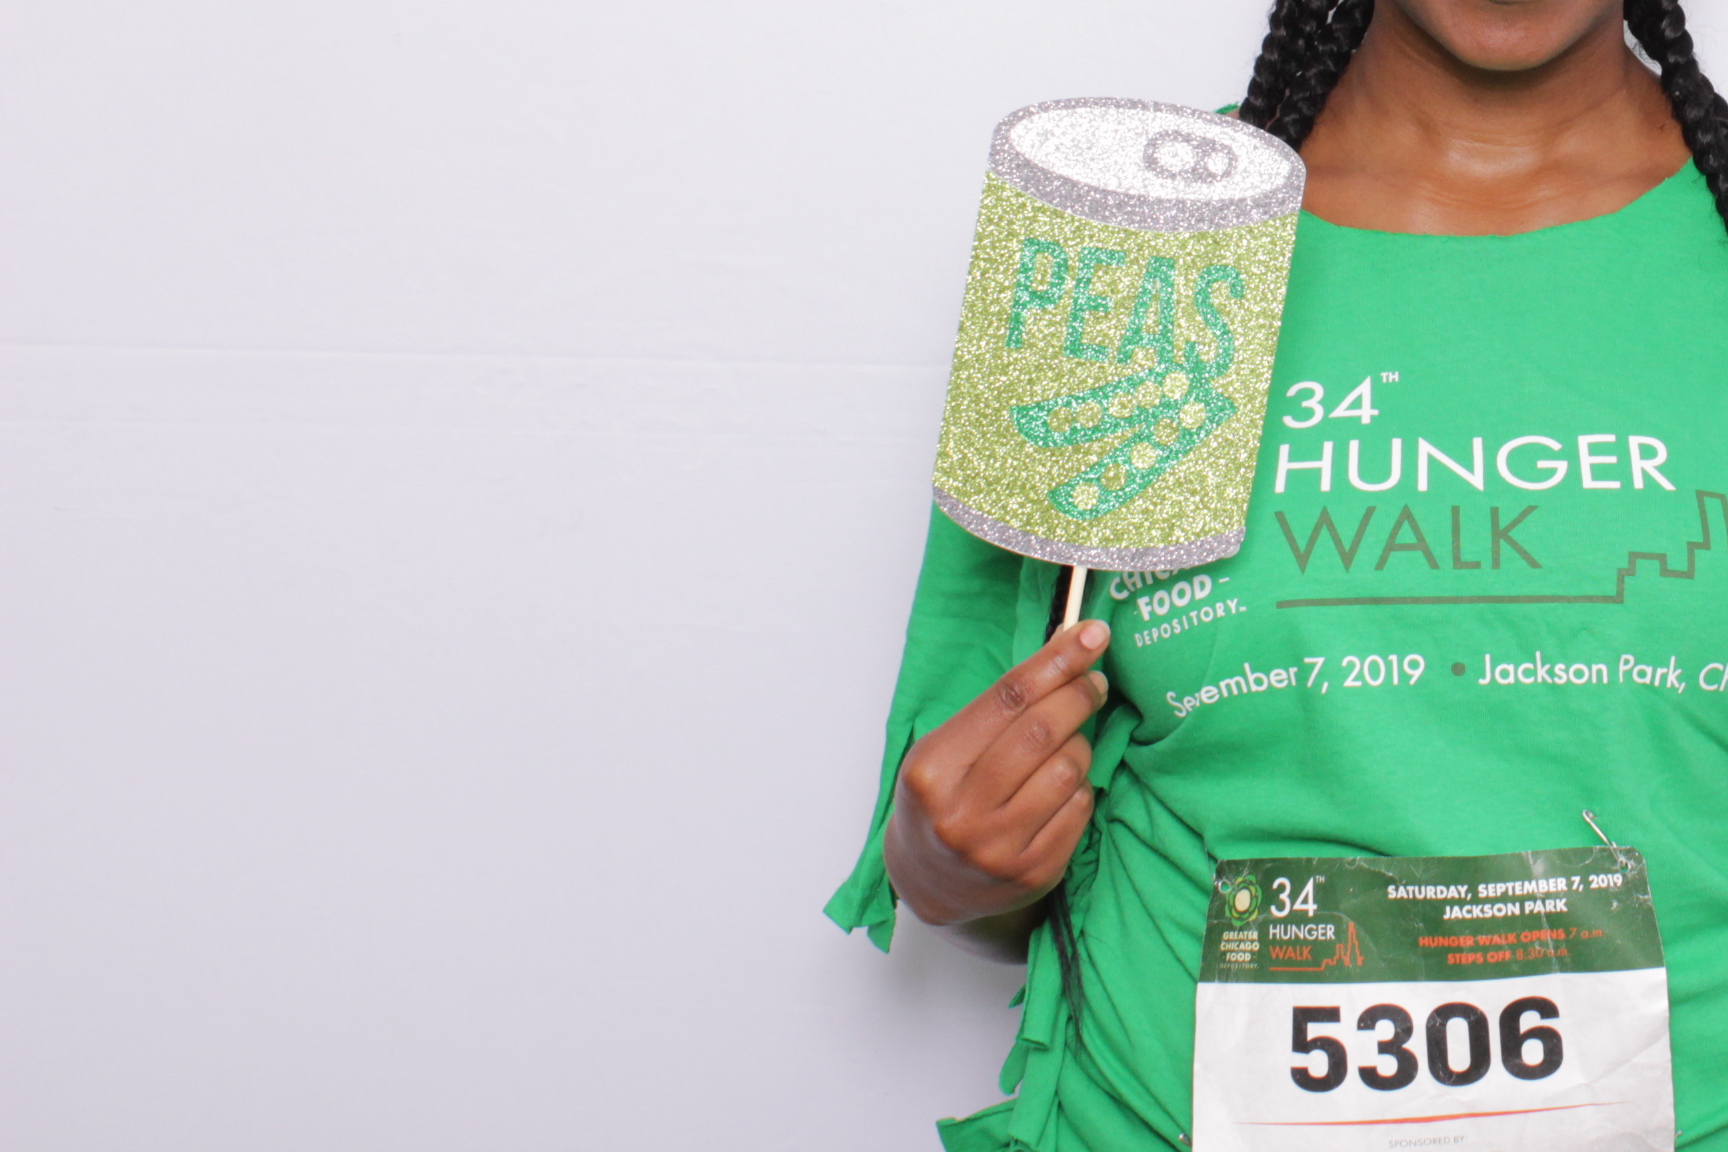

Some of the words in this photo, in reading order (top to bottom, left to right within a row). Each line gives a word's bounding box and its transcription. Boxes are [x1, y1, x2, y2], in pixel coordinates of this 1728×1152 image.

[1004, 237, 1246, 380] PEAS
[1273, 433, 1677, 494] HUNGER
[1273, 503, 1544, 575] WALK
[1136, 573, 1213, 622] FOOD
[1303, 656, 1329, 695] 7,
[1341, 653, 1426, 687] 2019
[1478, 651, 1609, 686] Jackson
[1618, 653, 1687, 694] Park,
[1387, 884, 1473, 901] SATURDAY,
[1477, 877, 1568, 898] SEPTEMBER
[1570, 875, 1585, 893] 7,
[1588, 873, 1624, 890] 2019
[1442, 900, 1521, 920] JACKSON
[1524, 898, 1569, 916] PARK
[1222, 930, 1259, 941] GREATER
[1269, 923, 1336, 941] HUNGER
[1418, 935, 1475, 948] HUNGER
[1477, 932, 1518, 946] WALK
[1520, 928, 1567, 943] OPENS
[1569, 927, 1579, 939] 7
[1220, 941, 1260, 952] CHICAGO
[1268, 945, 1313, 961] WALK
[1446, 952, 1484, 965] STEPS
[1486, 950, 1512, 964] OFF
[1515, 947, 1545, 961] 8:30
[1225, 952, 1252, 963] FOOD
[1289, 995, 1565, 1094] 5306
[1388, 1135, 1451, 1149] SPONSORED
